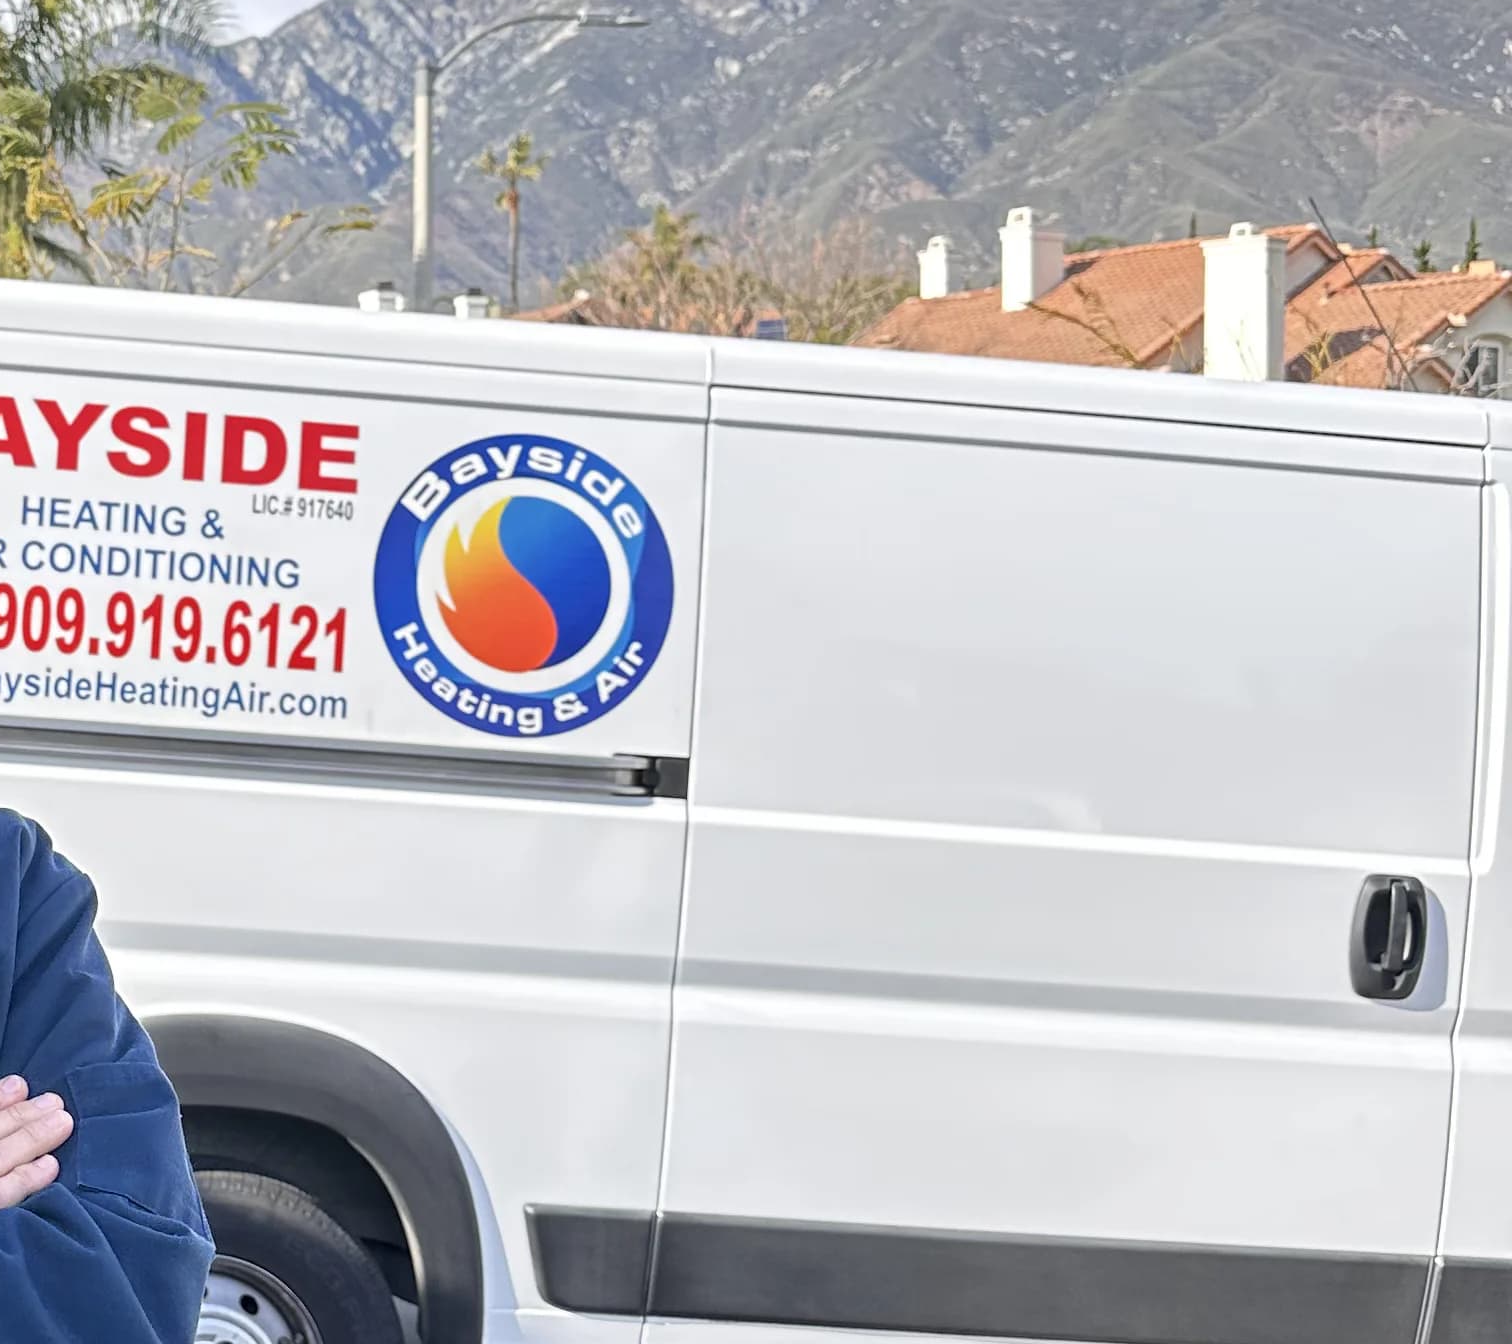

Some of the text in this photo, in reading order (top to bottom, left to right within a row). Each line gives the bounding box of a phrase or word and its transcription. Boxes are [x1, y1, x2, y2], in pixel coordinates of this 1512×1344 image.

[297, 497, 354, 521] 917640
[400, 444, 644, 539] Bayside
[21, 495, 226, 539] HEATING &
[21, 540, 301, 589] CONDITIONING
[393, 622, 644, 734] Heating & Air
